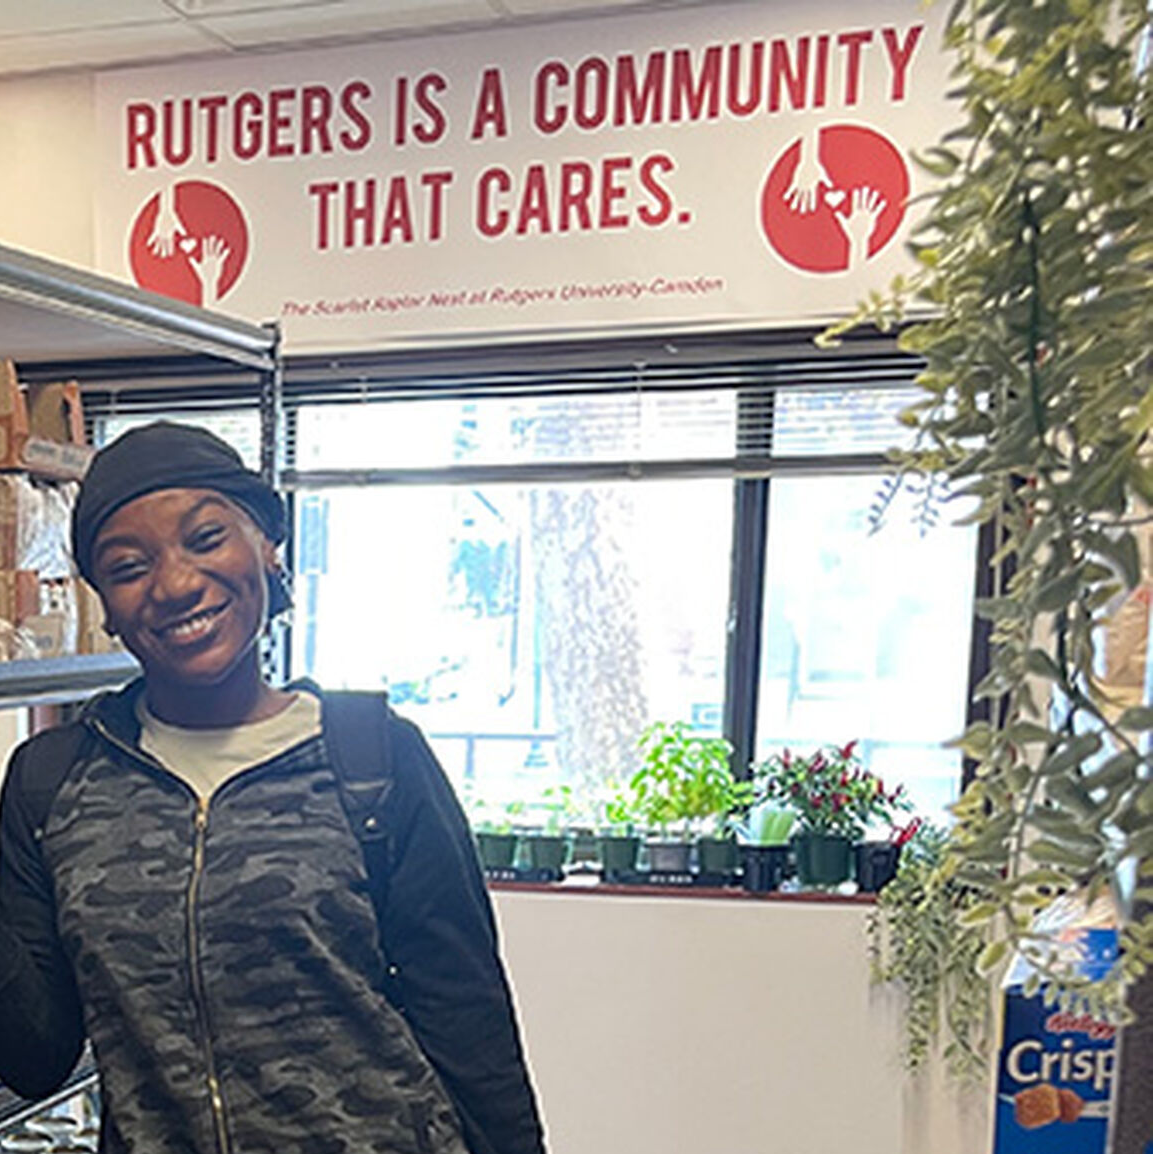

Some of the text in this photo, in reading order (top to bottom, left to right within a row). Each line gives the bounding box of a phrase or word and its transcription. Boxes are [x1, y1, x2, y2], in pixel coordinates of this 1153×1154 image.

[126, 26, 924, 170] RUTGERS IS A COMMUNITY
[309, 154, 691, 251] THAT CARES.
